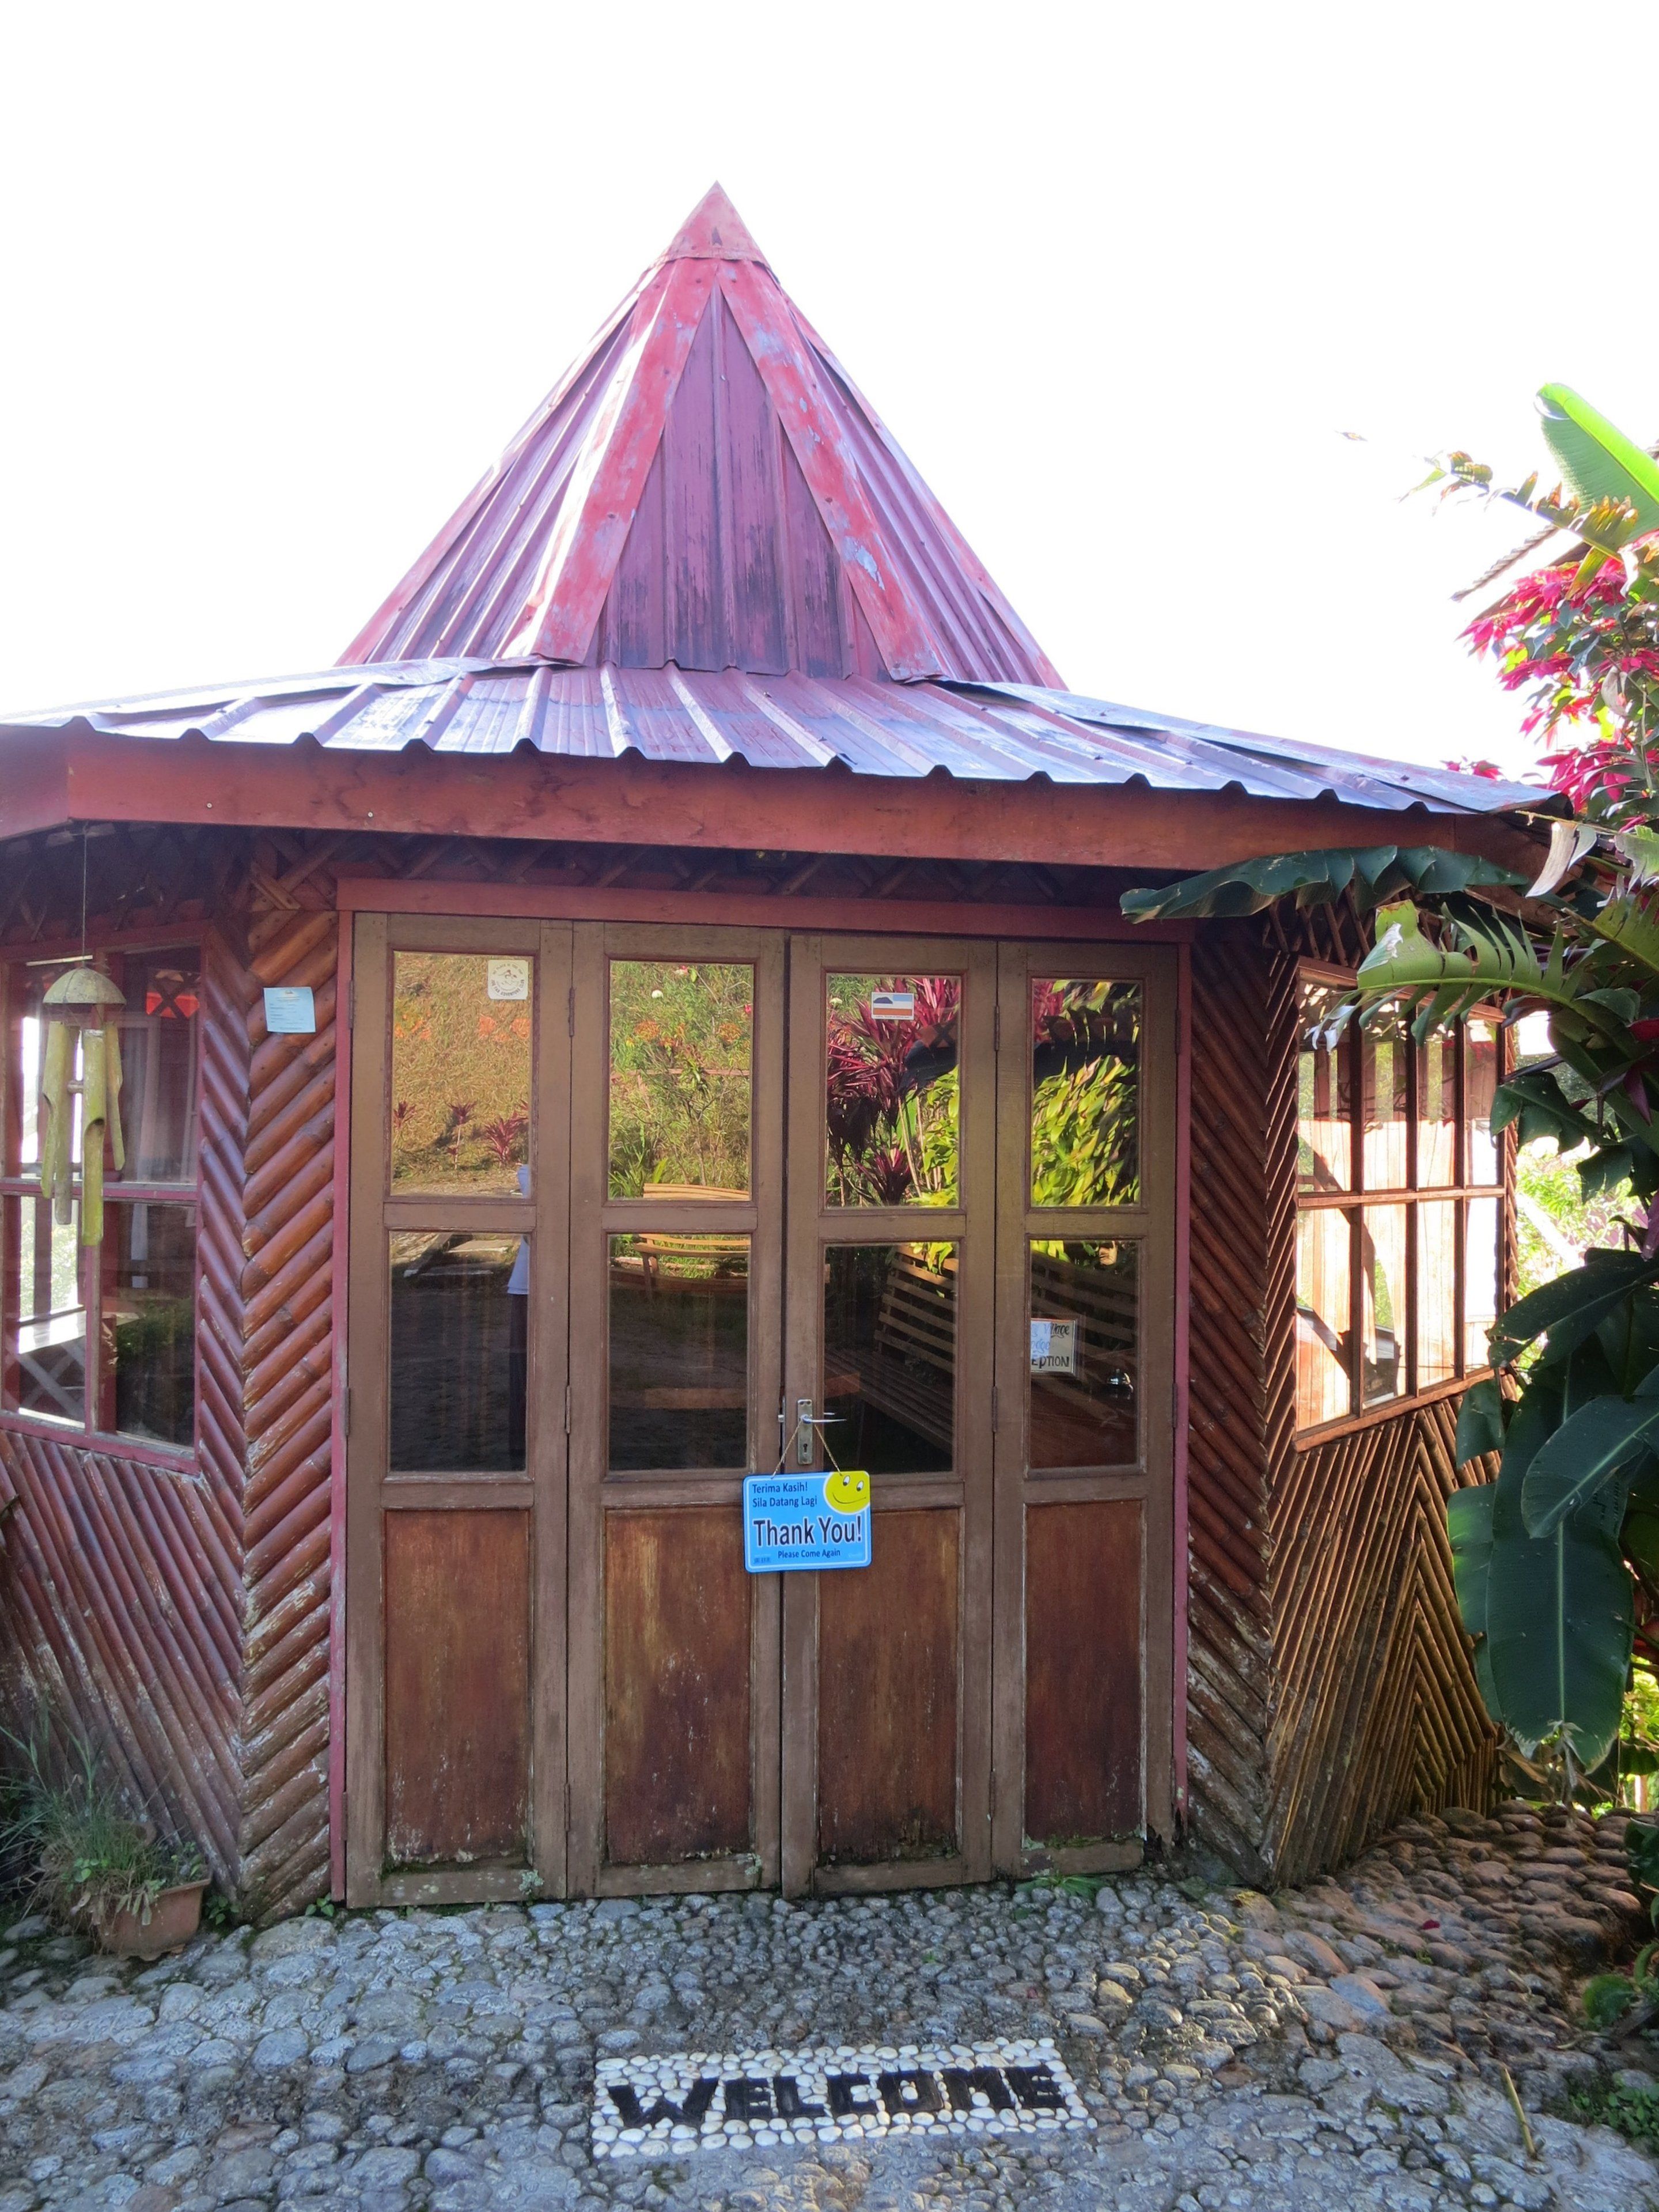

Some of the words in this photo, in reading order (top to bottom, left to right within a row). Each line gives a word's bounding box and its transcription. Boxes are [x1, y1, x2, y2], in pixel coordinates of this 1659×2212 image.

[752, 1483, 781, 1494] Terima
[783, 1482, 808, 1492] Kasih!
[752, 1498, 767, 1508] Sila
[770, 1497, 799, 1508] Datang
[801, 1495, 817, 1507] Lagi
[753, 1518, 815, 1546] Thank
[818, 1516, 861, 1543] You!
[778, 1550, 799, 1558] Please
[801, 1550, 820, 1558] Come
[822, 1548, 840, 1558] Again
[608, 2065, 1066, 2127] WELCOME
